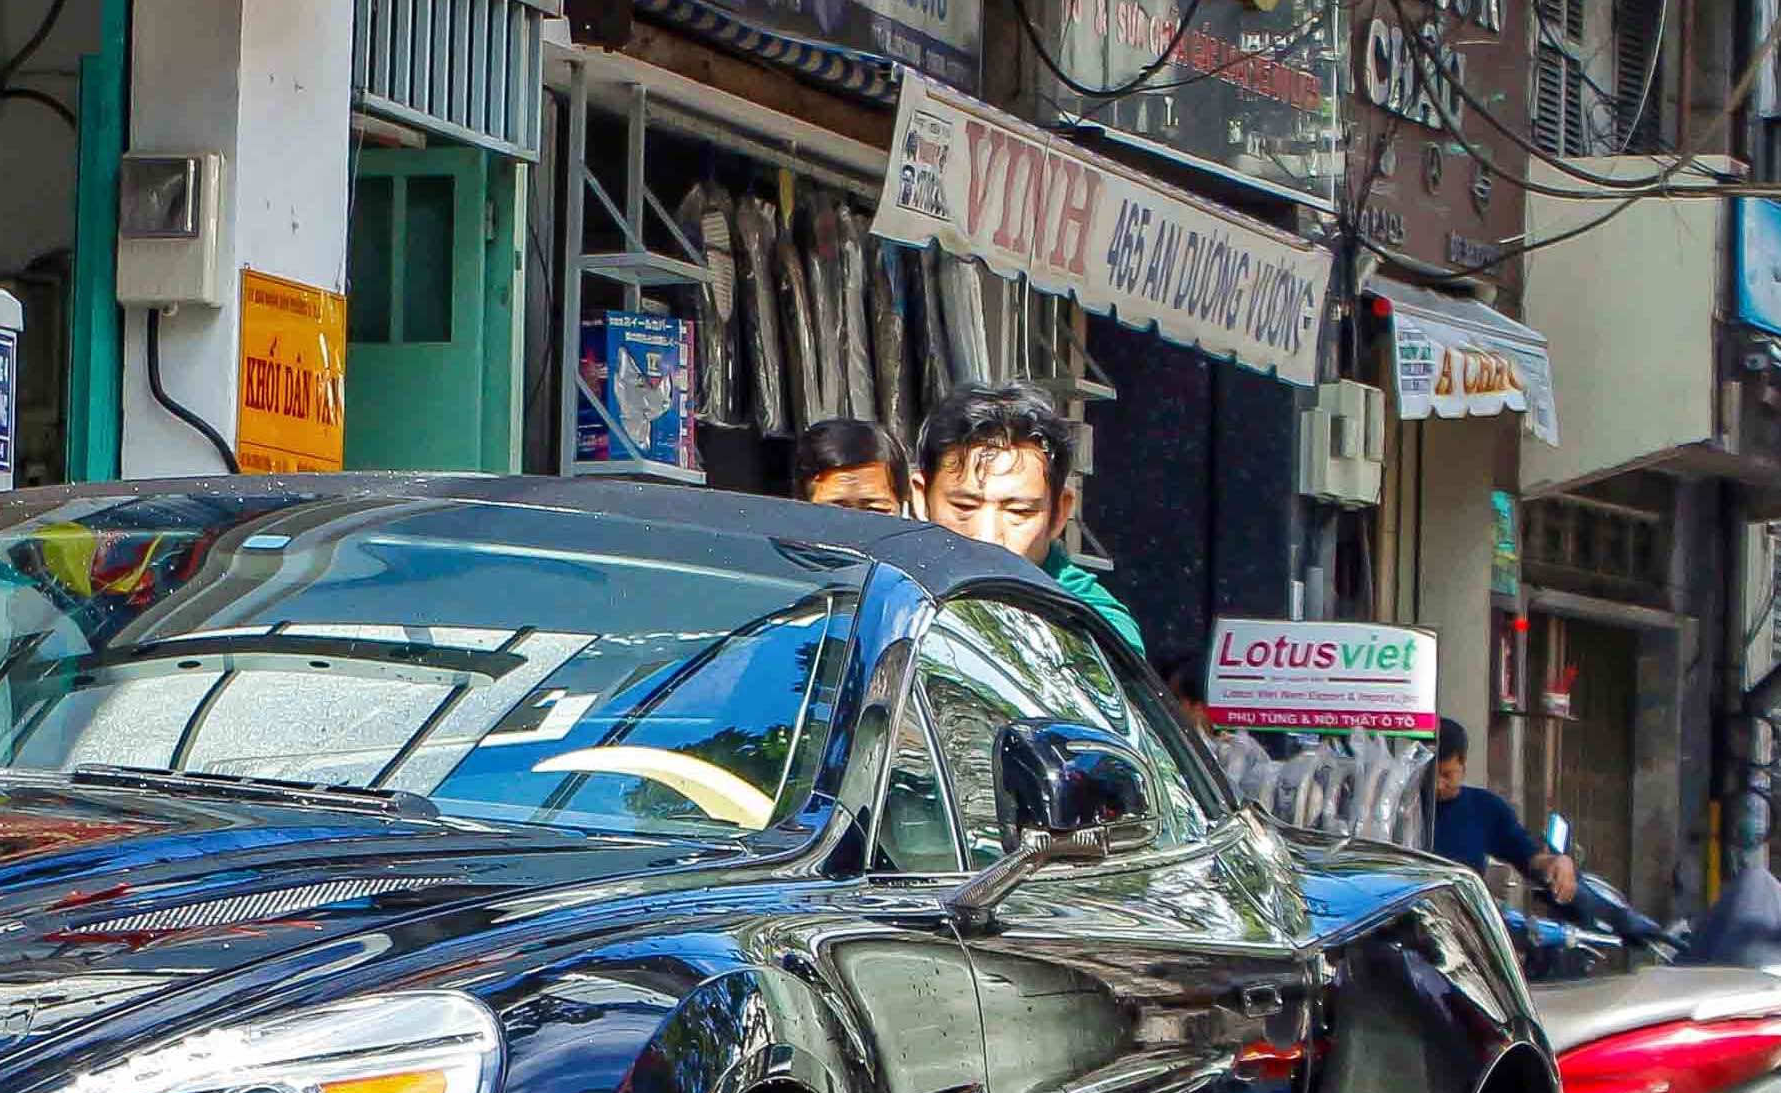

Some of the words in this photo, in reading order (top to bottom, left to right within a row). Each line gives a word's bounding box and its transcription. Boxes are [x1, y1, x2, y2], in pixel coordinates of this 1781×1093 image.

[965, 120, 1105, 275] VINH
[1107, 198, 1153, 294] 465
[1142, 219, 1184, 304] AN
[1227, 711, 1256, 725] PHỤ
